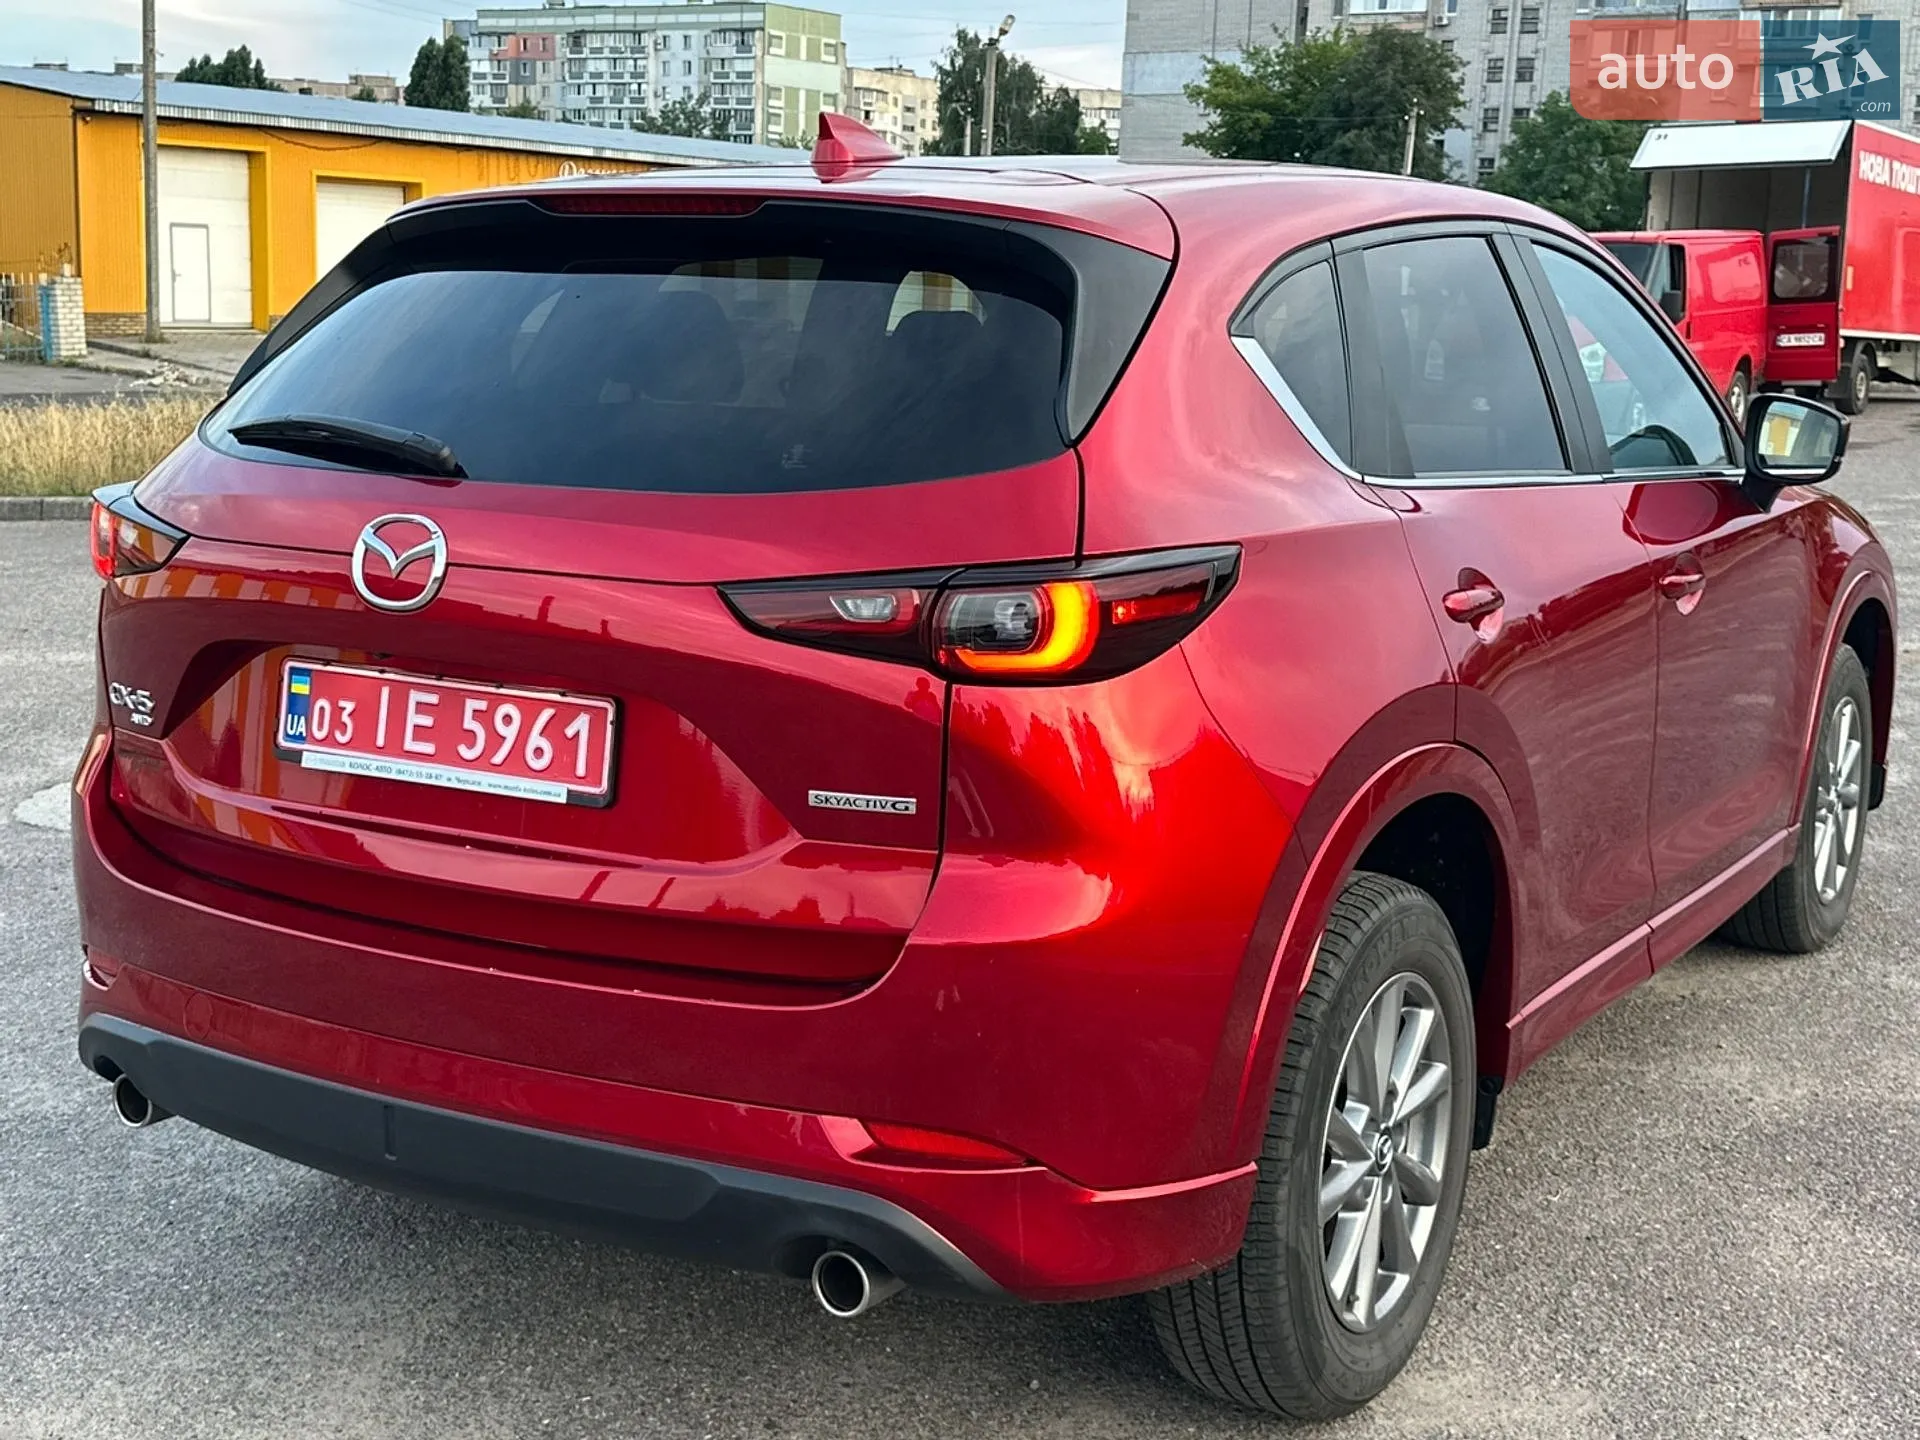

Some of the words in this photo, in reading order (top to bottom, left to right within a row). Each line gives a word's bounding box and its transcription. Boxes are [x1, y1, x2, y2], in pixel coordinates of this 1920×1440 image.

[1859, 150, 1891, 188] НОВА
[109, 682, 155, 713] CX-5
[286, 713, 307, 737] UA
[311, 698, 356, 744] 03
[375, 686, 440, 756] IE
[457, 698, 591, 779] 5961
